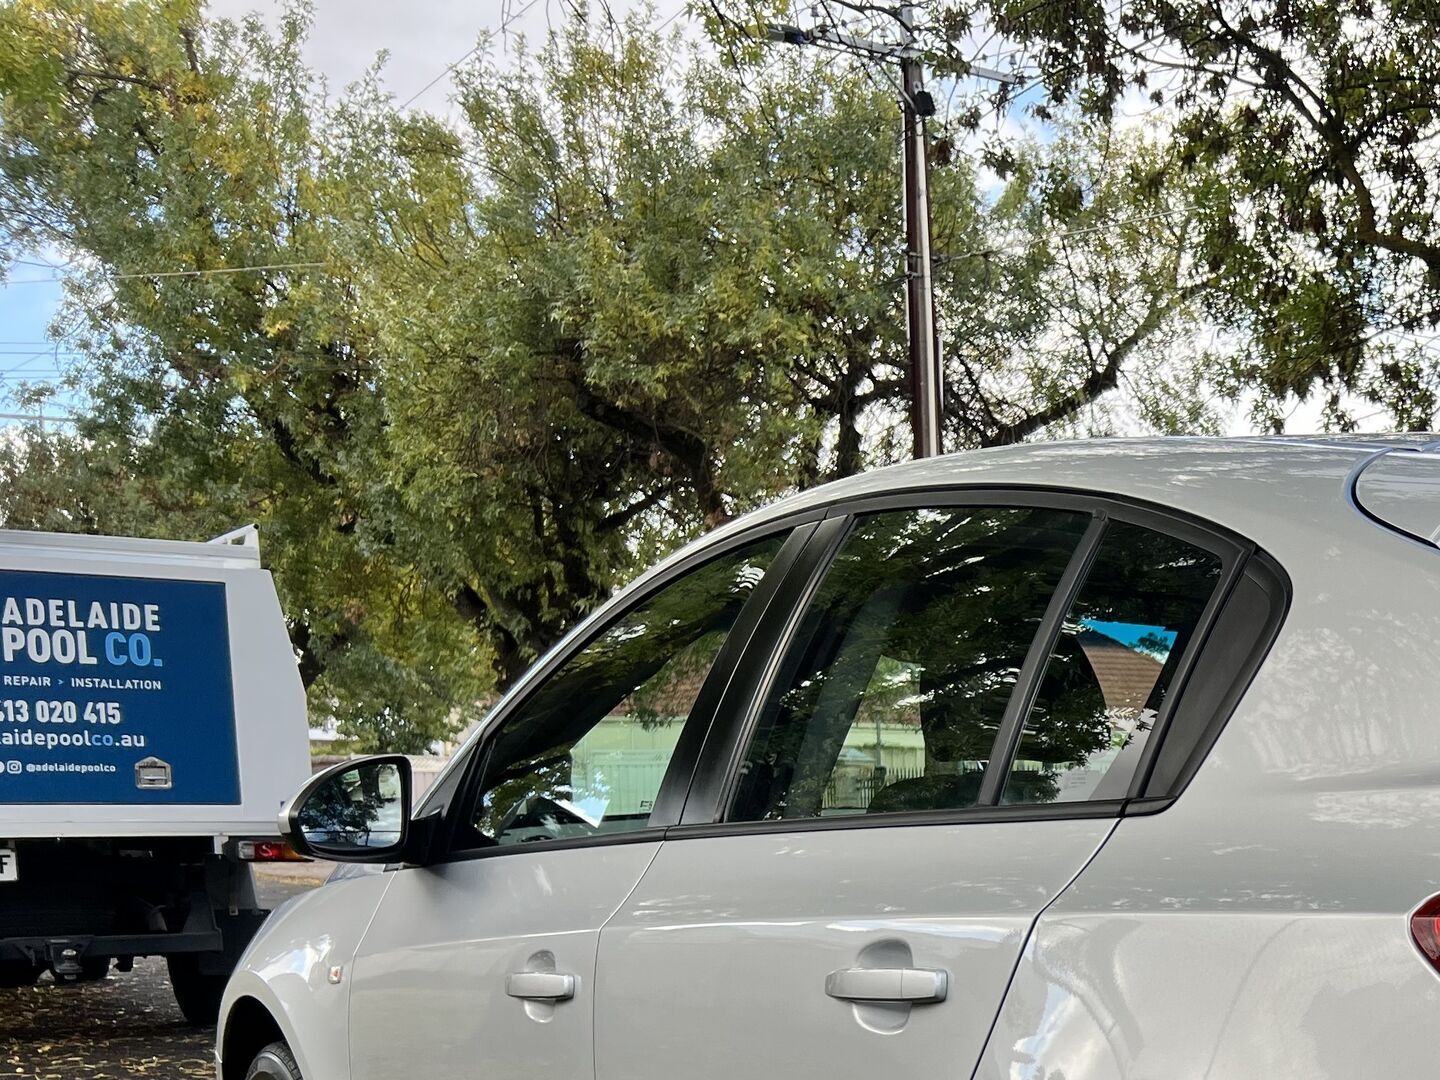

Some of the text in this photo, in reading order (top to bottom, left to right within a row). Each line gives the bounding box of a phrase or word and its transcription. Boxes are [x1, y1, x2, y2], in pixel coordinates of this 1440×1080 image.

[2, 597, 161, 631] ADELAIDE
[2, 627, 163, 667] POOL CO.
[4, 675, 162, 690] REPAIR INSTALLATION
[35, 700, 77, 723] 020
[83, 701, 121, 724] 415
[0, 728, 145, 750] aidepoolco.au
[26, 763, 116, 774] @adelaidepoolco
